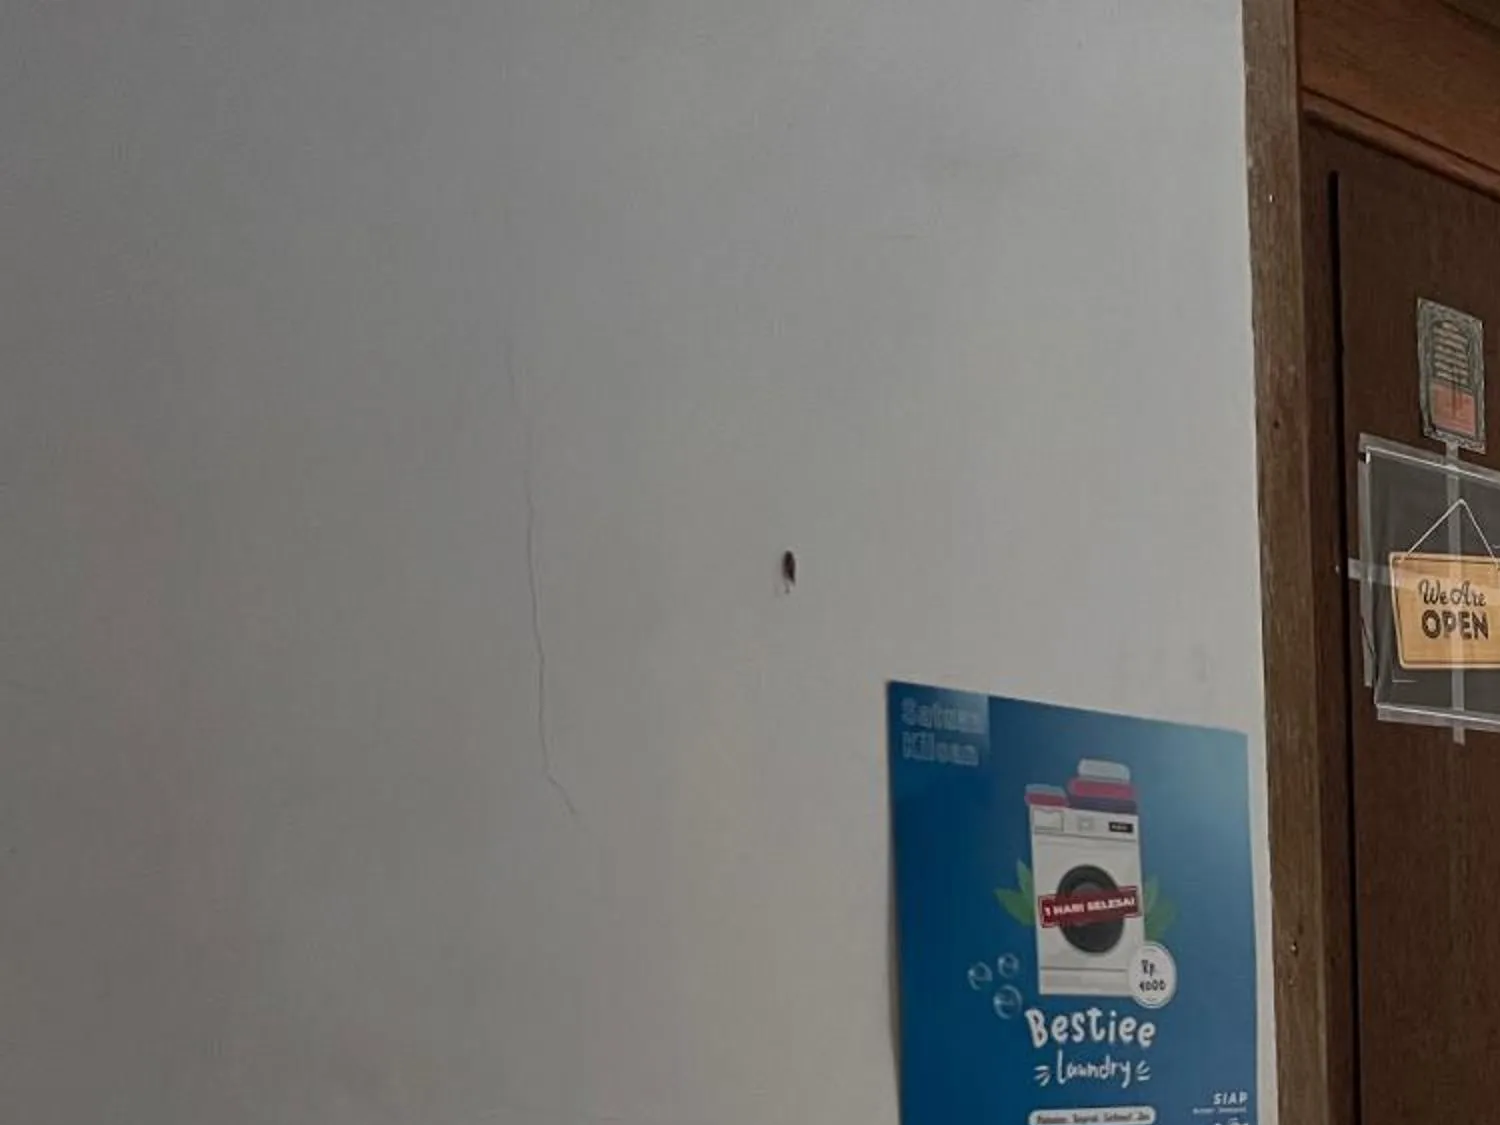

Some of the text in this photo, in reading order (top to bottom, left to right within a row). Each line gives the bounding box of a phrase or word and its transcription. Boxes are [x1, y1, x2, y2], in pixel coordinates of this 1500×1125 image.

[1418, 579, 1487, 607] We Are
[1422, 610, 1489, 640] OPEN
[1024, 1007, 1157, 1049] Bestiee
[1213, 1091, 1249, 1105] SIAP
